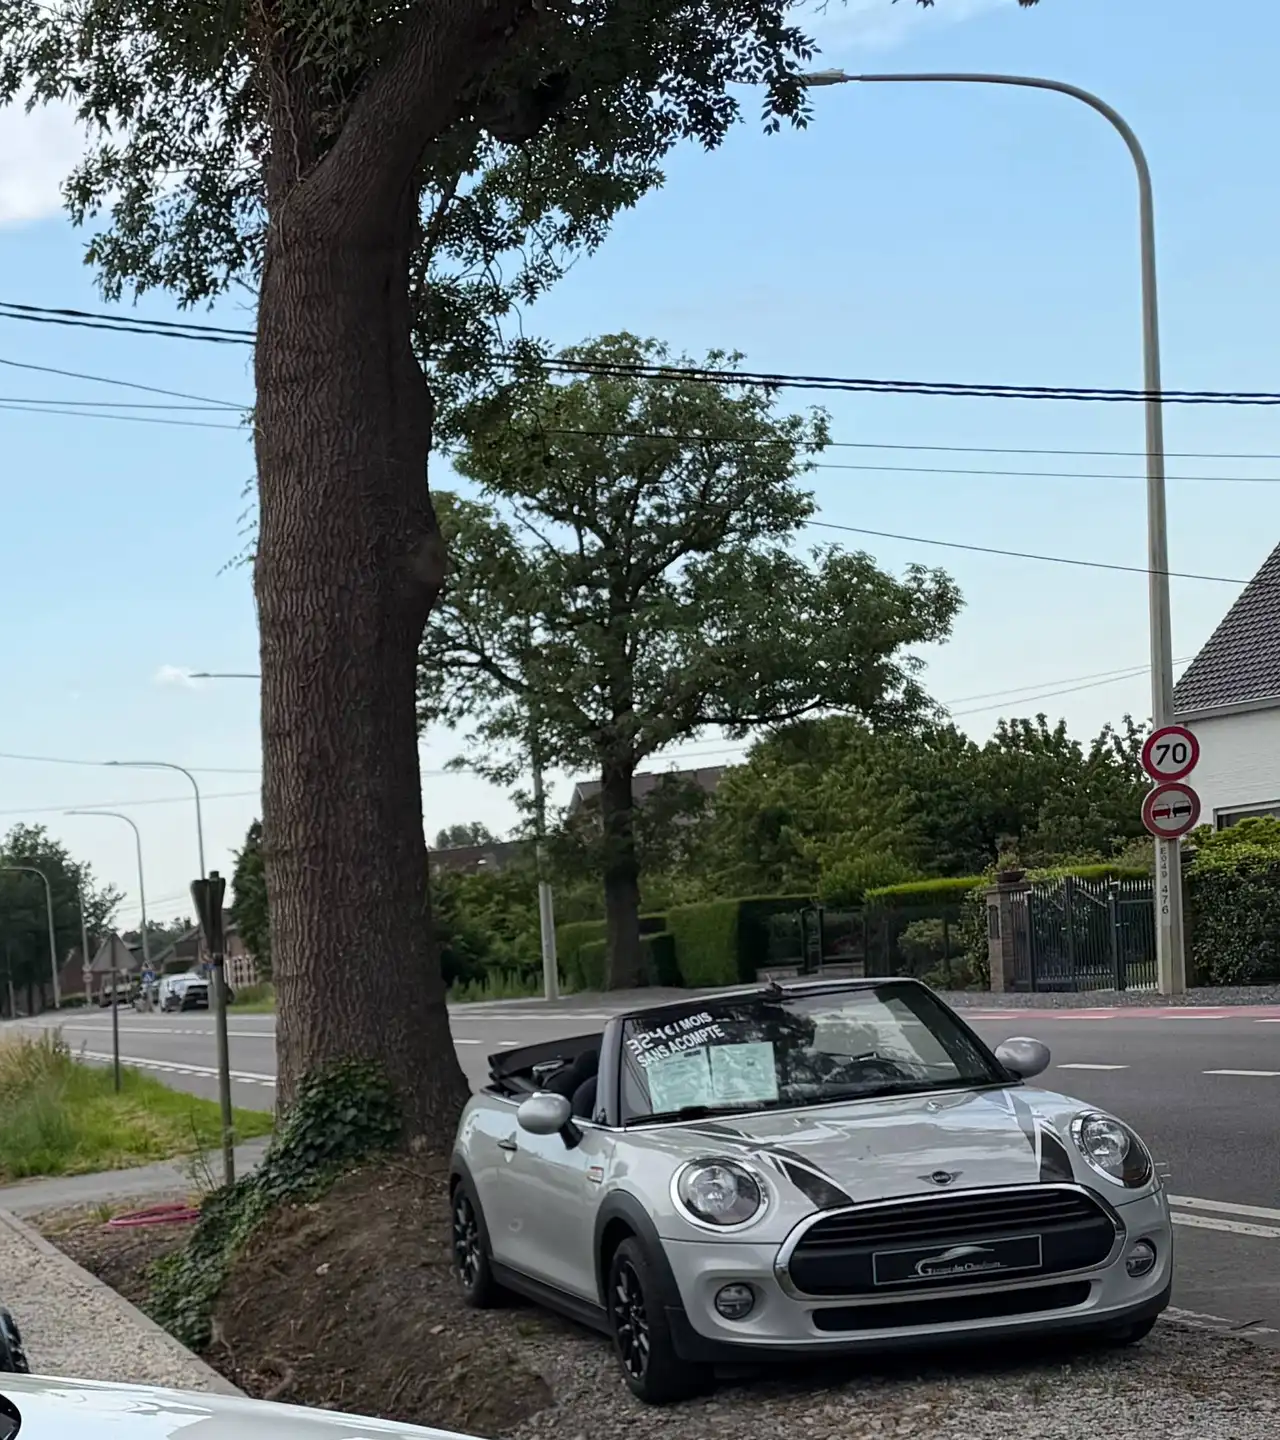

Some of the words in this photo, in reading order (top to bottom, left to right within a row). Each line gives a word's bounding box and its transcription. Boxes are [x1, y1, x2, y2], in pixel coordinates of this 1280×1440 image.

[1156, 743, 1187, 765] 70
[636, 1046, 671, 1068] SANS
[670, 1024, 726, 1053] ACOMPTE
